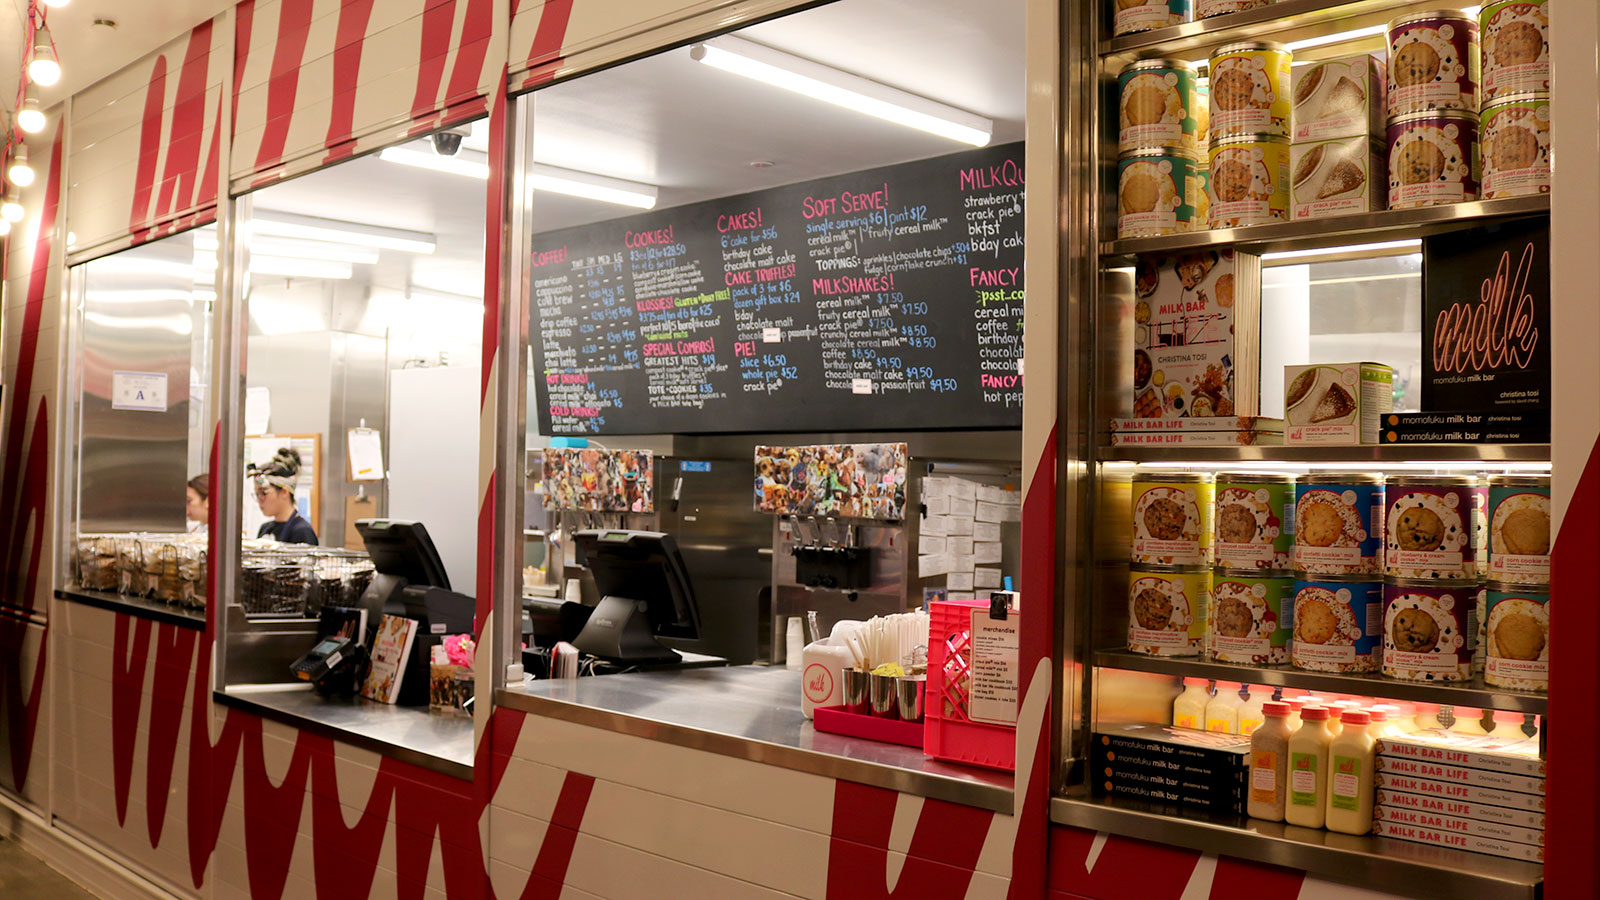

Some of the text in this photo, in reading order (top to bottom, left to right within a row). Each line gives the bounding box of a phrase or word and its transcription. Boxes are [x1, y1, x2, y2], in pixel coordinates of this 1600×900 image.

[964, 192, 1017, 208] strawberry
[717, 208, 762, 233] CAKES!
[806, 218, 833, 237] single
[836, 216, 868, 232] serving
[910, 205, 928, 221] $12
[966, 208, 995, 221] crack
[625, 224, 674, 248] COOKIES!
[730, 225, 777, 246] cake for $56
[808, 223, 920, 245] cereal fruity cereal
[968, 220, 1000, 237] bkfst
[722, 242, 772, 261] birthday cake
[809, 245, 831, 256] crack
[724, 250, 796, 271] chocolate malt cake
[816, 256, 861, 271] TOPPINGS:
[725, 271, 752, 286] CAKE
[812, 273, 895, 296] MILKSHAKES!
[970, 267, 1019, 287] FANCY
[732, 280, 791, 302] pack for $6
[734, 291, 800, 311] dozen gift box $24
[816, 296, 842, 309] cereal
[1160, 301, 1205, 314] MILK BAR
[1433, 242, 1538, 373] milk
[818, 305, 870, 322] fruity cereal
[974, 303, 1009, 319] cereal
[737, 316, 793, 331] chocolate malt
[819, 320, 841, 330] crack
[976, 319, 1008, 333] coffee
[820, 329, 871, 341] crunchy cereal
[977, 333, 1018, 348] birthday
[643, 342, 677, 356] SPECIAL
[734, 341, 756, 357] PIE!
[821, 338, 880, 349] chocolate cereal
[644, 354, 716, 366] GREATEST HITS $19
[740, 354, 786, 367] slice $6.50
[822, 349, 847, 359] coffee
[1158, 355, 1191, 363] CHRISTINA
[823, 359, 852, 370] birthday
[854, 358, 873, 370] cake
[742, 369, 763, 379] whole
[766, 370, 778, 382] pie
[781, 366, 798, 379] $52
[825, 367, 933, 380] chocolate malt cake $9.50
[981, 374, 1018, 388] FANCY
[1467, 374, 1481, 382] milk
[1483, 373, 1495, 381] bar
[743, 381, 765, 391] crack
[881, 378, 957, 394] passionfruit $9.50
[136, 390, 144, 400] A
[984, 391, 1001, 402] hot
[1123, 421, 1144, 429] MILK
[1146, 421, 1163, 429] BAR
[1402, 415, 1482, 425] momofuku milk bar
[1123, 435, 1183, 444] MILK BAR LIFE
[1401, 432, 1480, 441] momofuku milk bar
[810, 672, 825, 692] milk
[1113, 739, 1146, 750] momofuku
[1162, 746, 1174, 754] bar
[1392, 745, 1469, 763] MILK BAR LIFE
[1118, 755, 1180, 770] momofuku milk bar
[1391, 761, 1469, 780] MILK BAR LIFE
[1116, 771, 1178, 786] momofuku milk bar
[1116, 785, 1149, 796] momofuku
[1166, 792, 1178, 800] bar
[1391, 778, 1469, 797] MILK BAR LIFE
[1392, 795, 1418, 806] MILK
[1422, 799, 1444, 810] BAR
[1448, 803, 1470, 814] LIFE
[1390, 811, 1468, 831] MILK BAR LIFE
[1389, 826, 1467, 846] MILK BAR LIFE
